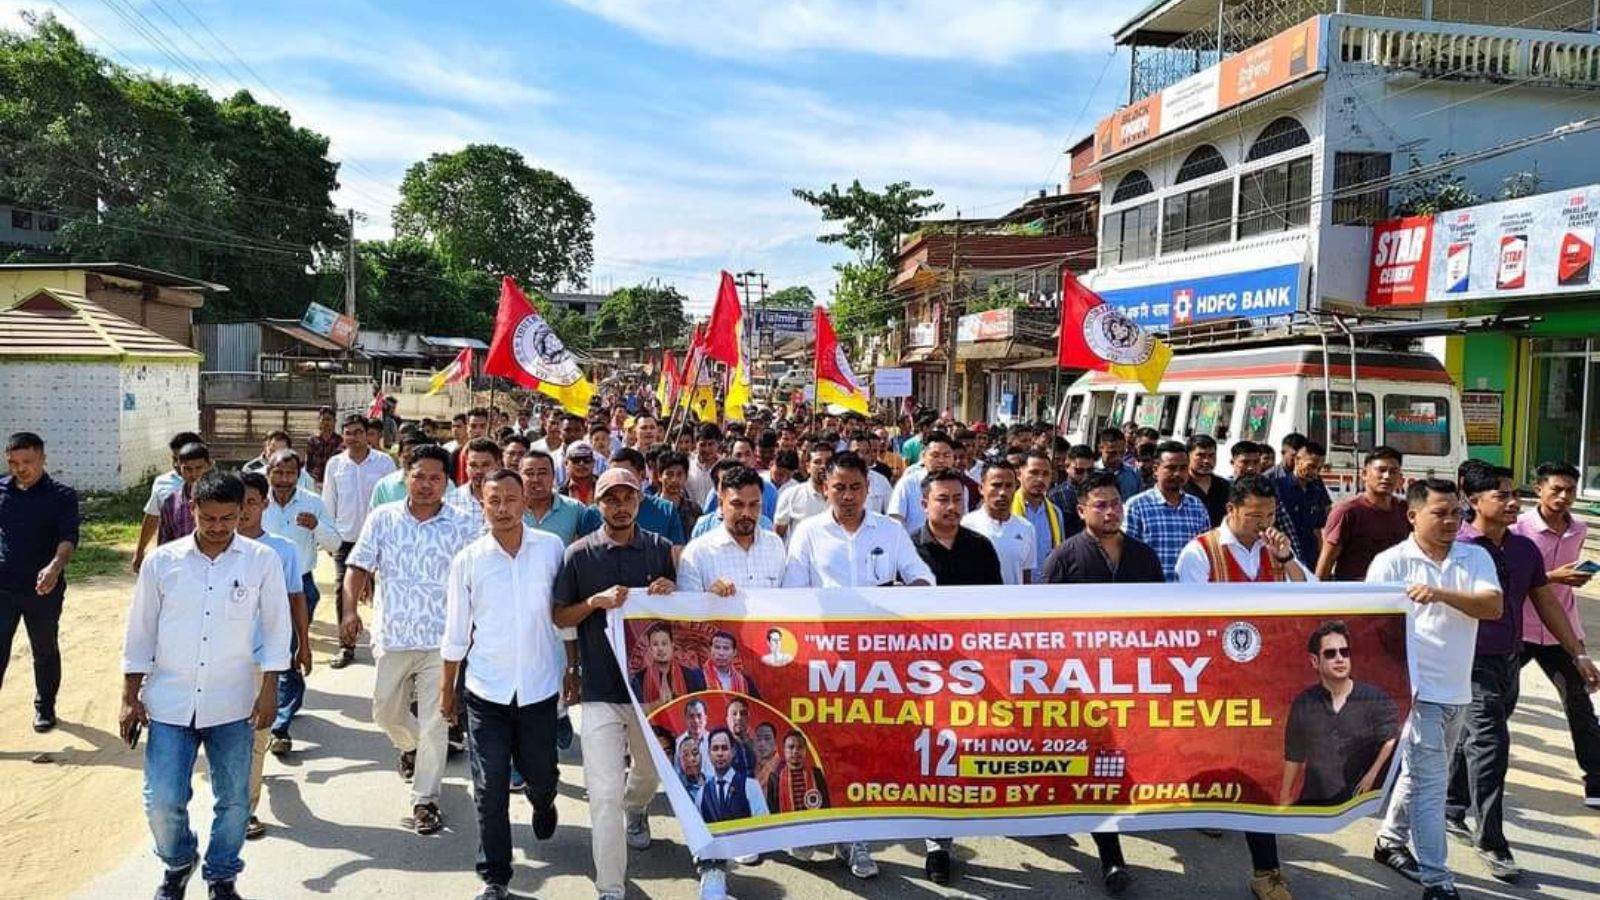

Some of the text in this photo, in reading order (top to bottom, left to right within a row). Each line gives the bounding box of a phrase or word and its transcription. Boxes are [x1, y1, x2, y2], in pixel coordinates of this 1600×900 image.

[1375, 225, 1427, 267] STAR
[1196, 294, 1237, 315] HDFC
[1242, 286, 1291, 310] BANK
[857, 633, 954, 651] DEMAND
[961, 631, 1067, 651] GREATER
[1072, 630, 1200, 649] TIPRALAND
[807, 656, 1211, 695] MASS RALLY
[790, 697, 1273, 728] DHALAI DISTRICT LEVEL
[913, 728, 1089, 777] 12 TH NOV. 2024
[974, 759, 1073, 774] TUESDAY
[846, 782, 998, 804] ORGANISED
[1005, 784, 1041, 803] BY
[1071, 784, 1121, 801] YTF
[1129, 782, 1242, 805] (DHALAI)
